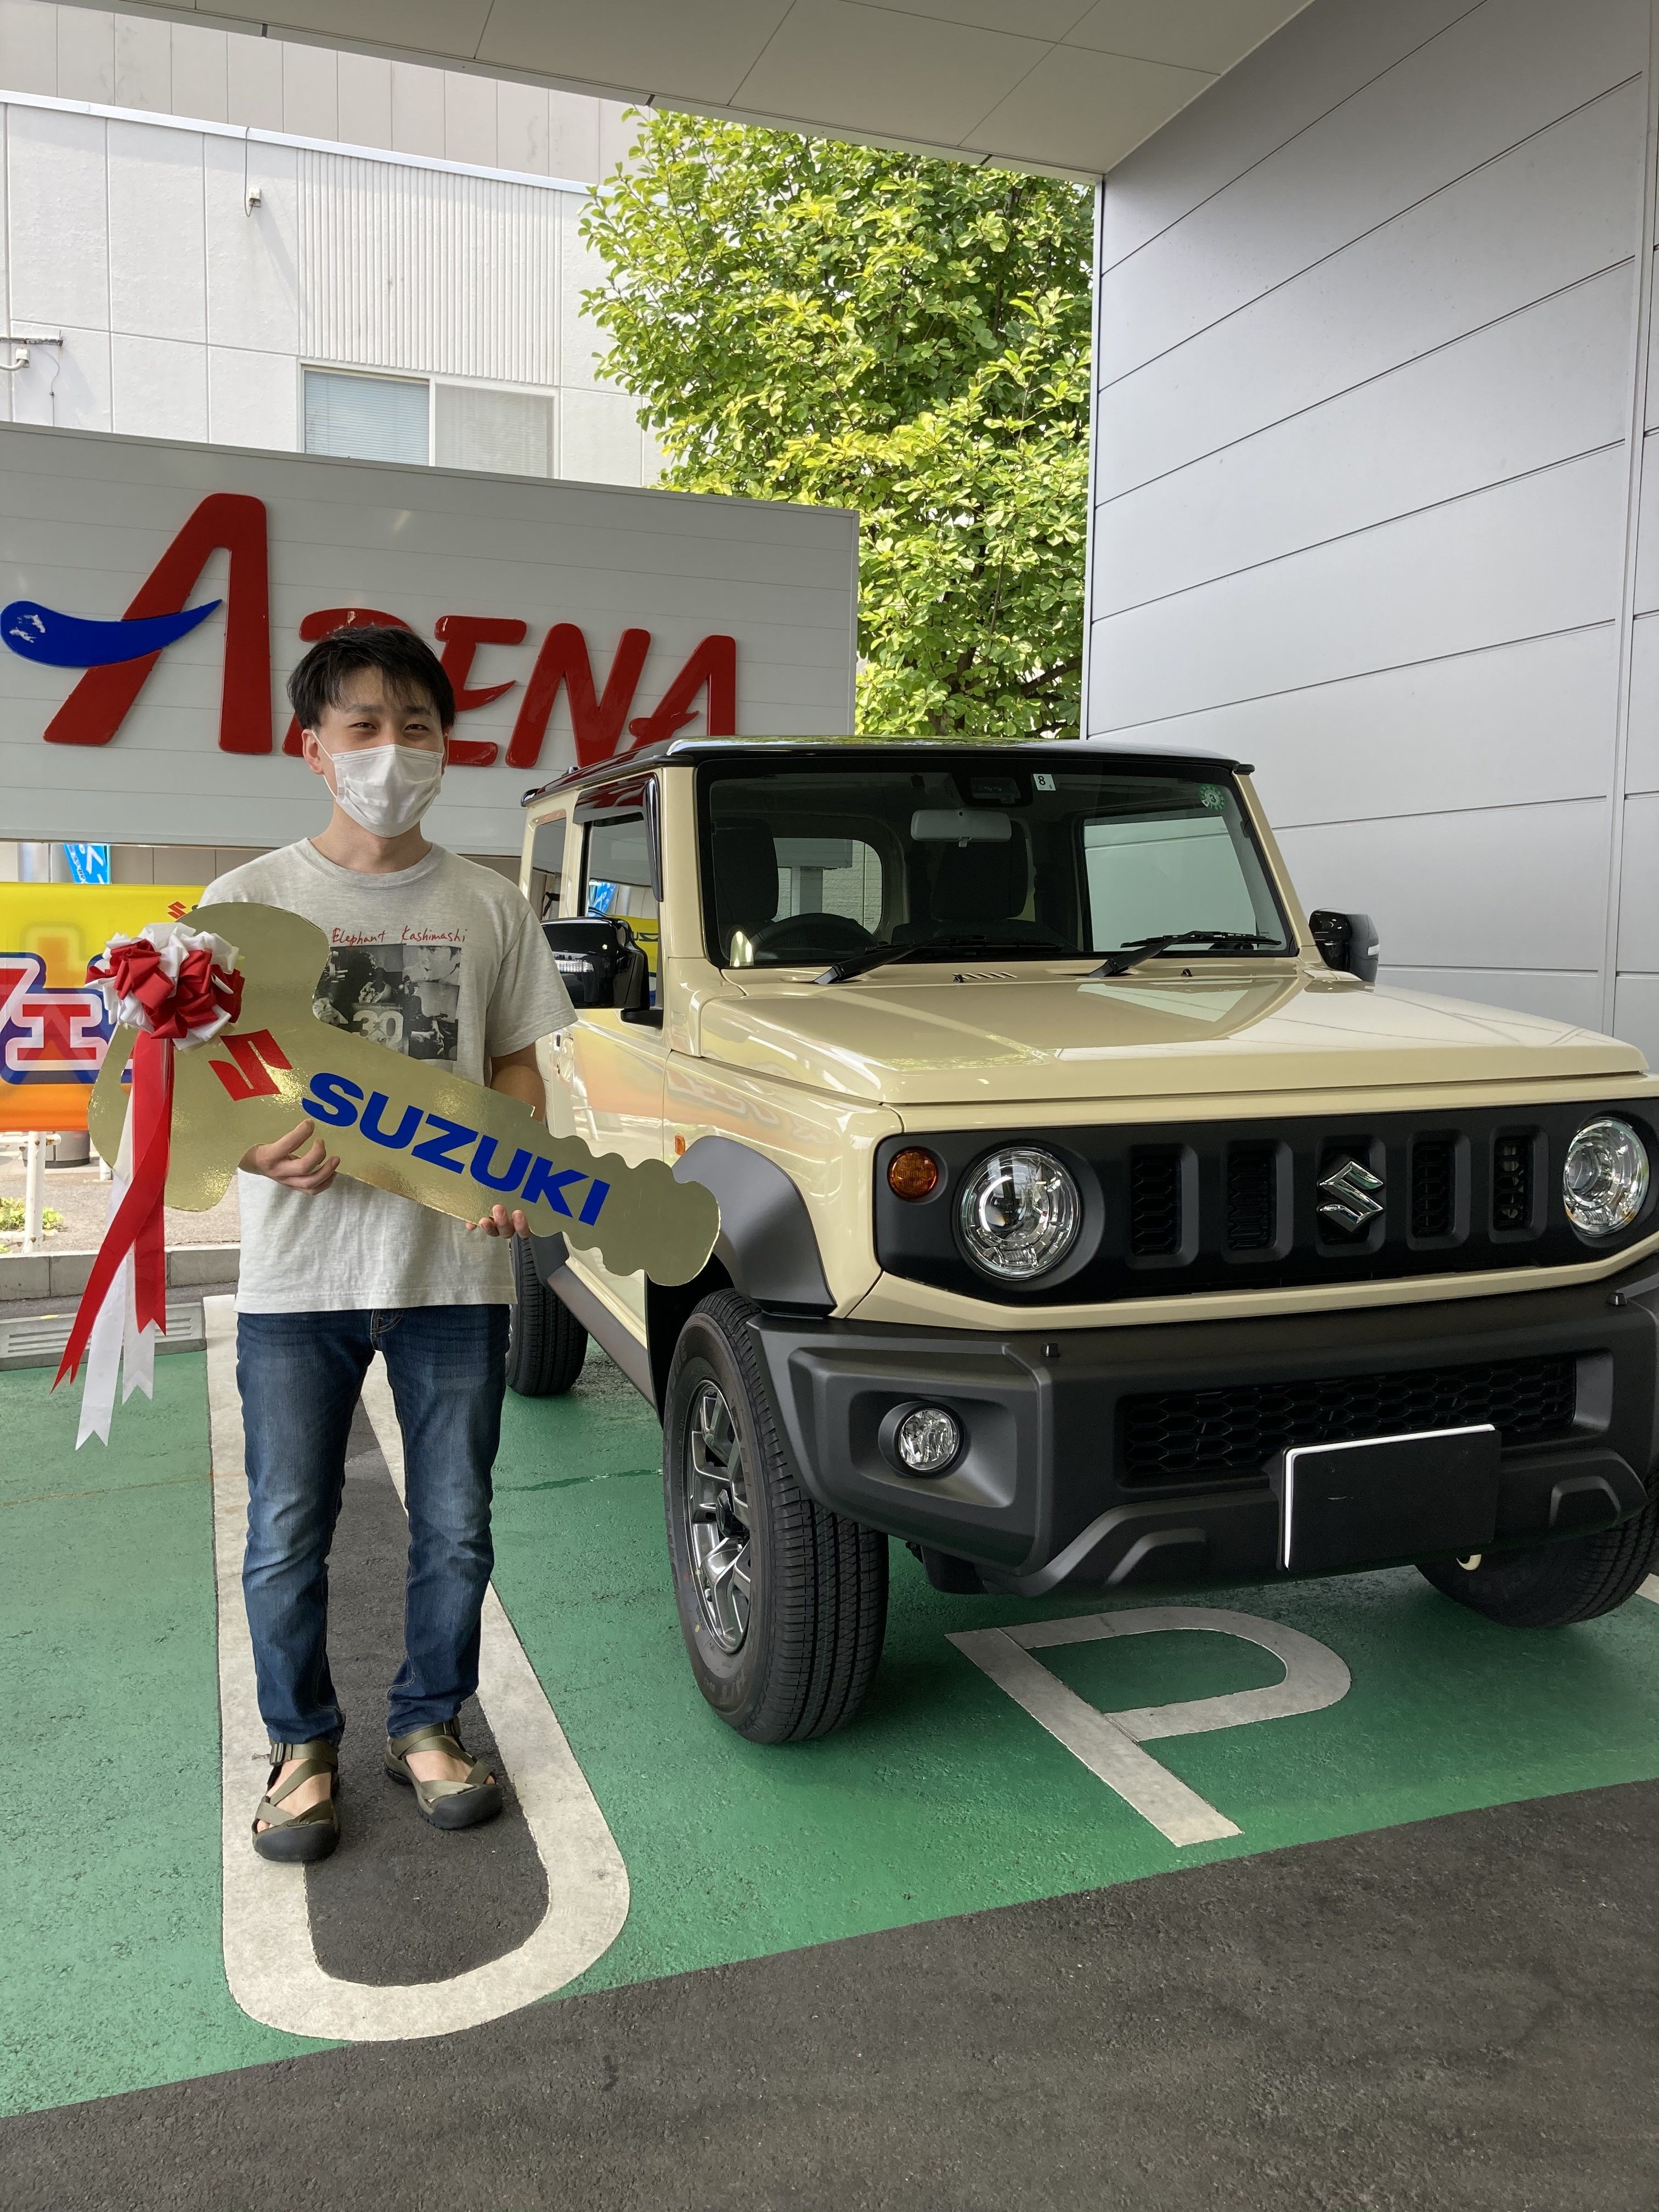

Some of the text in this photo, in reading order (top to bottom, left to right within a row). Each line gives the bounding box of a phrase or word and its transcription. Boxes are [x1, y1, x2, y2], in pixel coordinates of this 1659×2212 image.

[1038, 776, 1046, 785] 8
[1210, 794, 1216, 803] 3
[332, 925, 467, 952] Elephant Kashimashi
[302, 1072, 611, 1227] SUZUKI
[944, 1606, 1352, 1847] P
